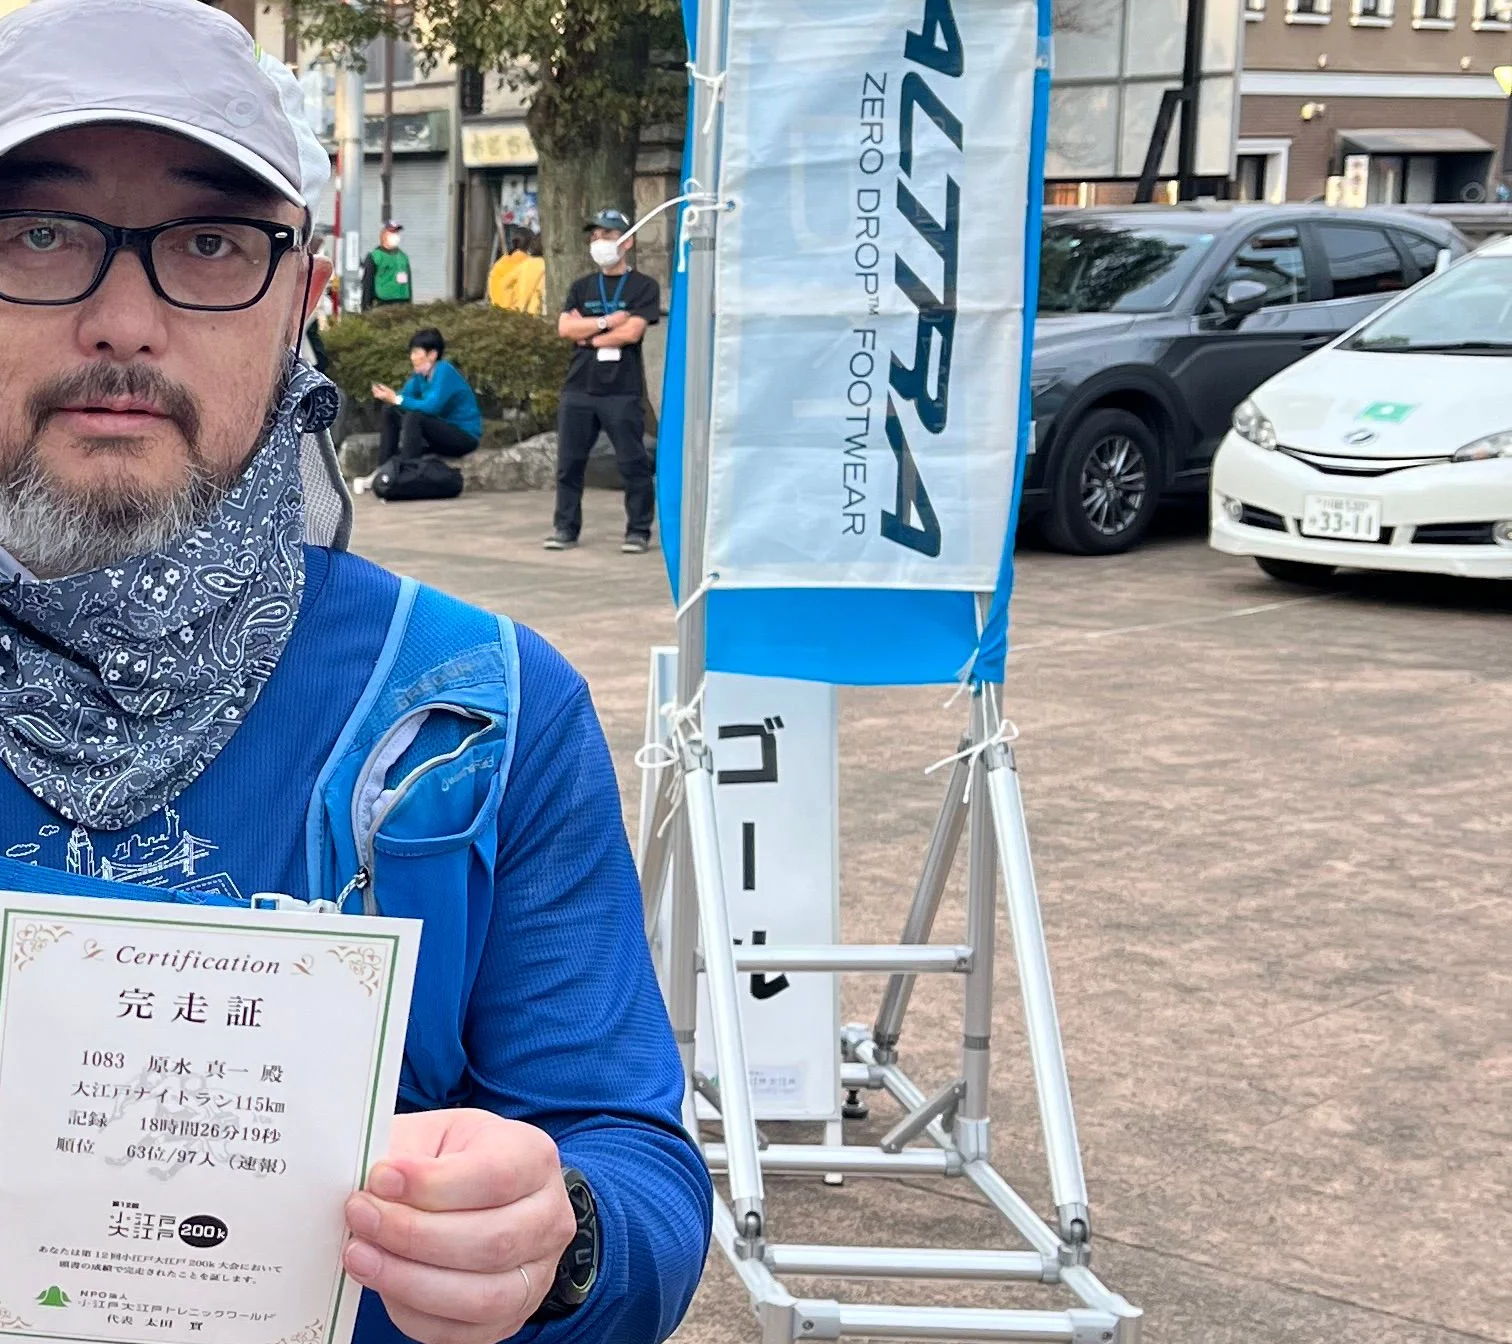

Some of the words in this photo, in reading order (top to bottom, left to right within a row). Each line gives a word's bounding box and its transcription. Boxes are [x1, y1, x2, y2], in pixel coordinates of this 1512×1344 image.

[858, 71, 887, 176] ZERO
[841, 328, 877, 536] FOOTWEAR
[115, 945, 280, 975] Certification
[117, 987, 265, 1028] 完走証
[80, 1050, 126, 1070] 1083
[146, 1055, 192, 1076] 原水
[205, 1059, 249, 1079] 真一
[260, 1064, 284, 1084] 殿
[71, 1080, 286, 1114] 大江戸ナイトラン115km
[68, 1109, 108, 1128] 記録
[139, 1117, 281, 1145] 18時間26分19秒
[55, 1136, 96, 1155] 順位
[108, 1225, 175, 1241] 大江戸
[109, 1211, 177, 1227] 小江戸
